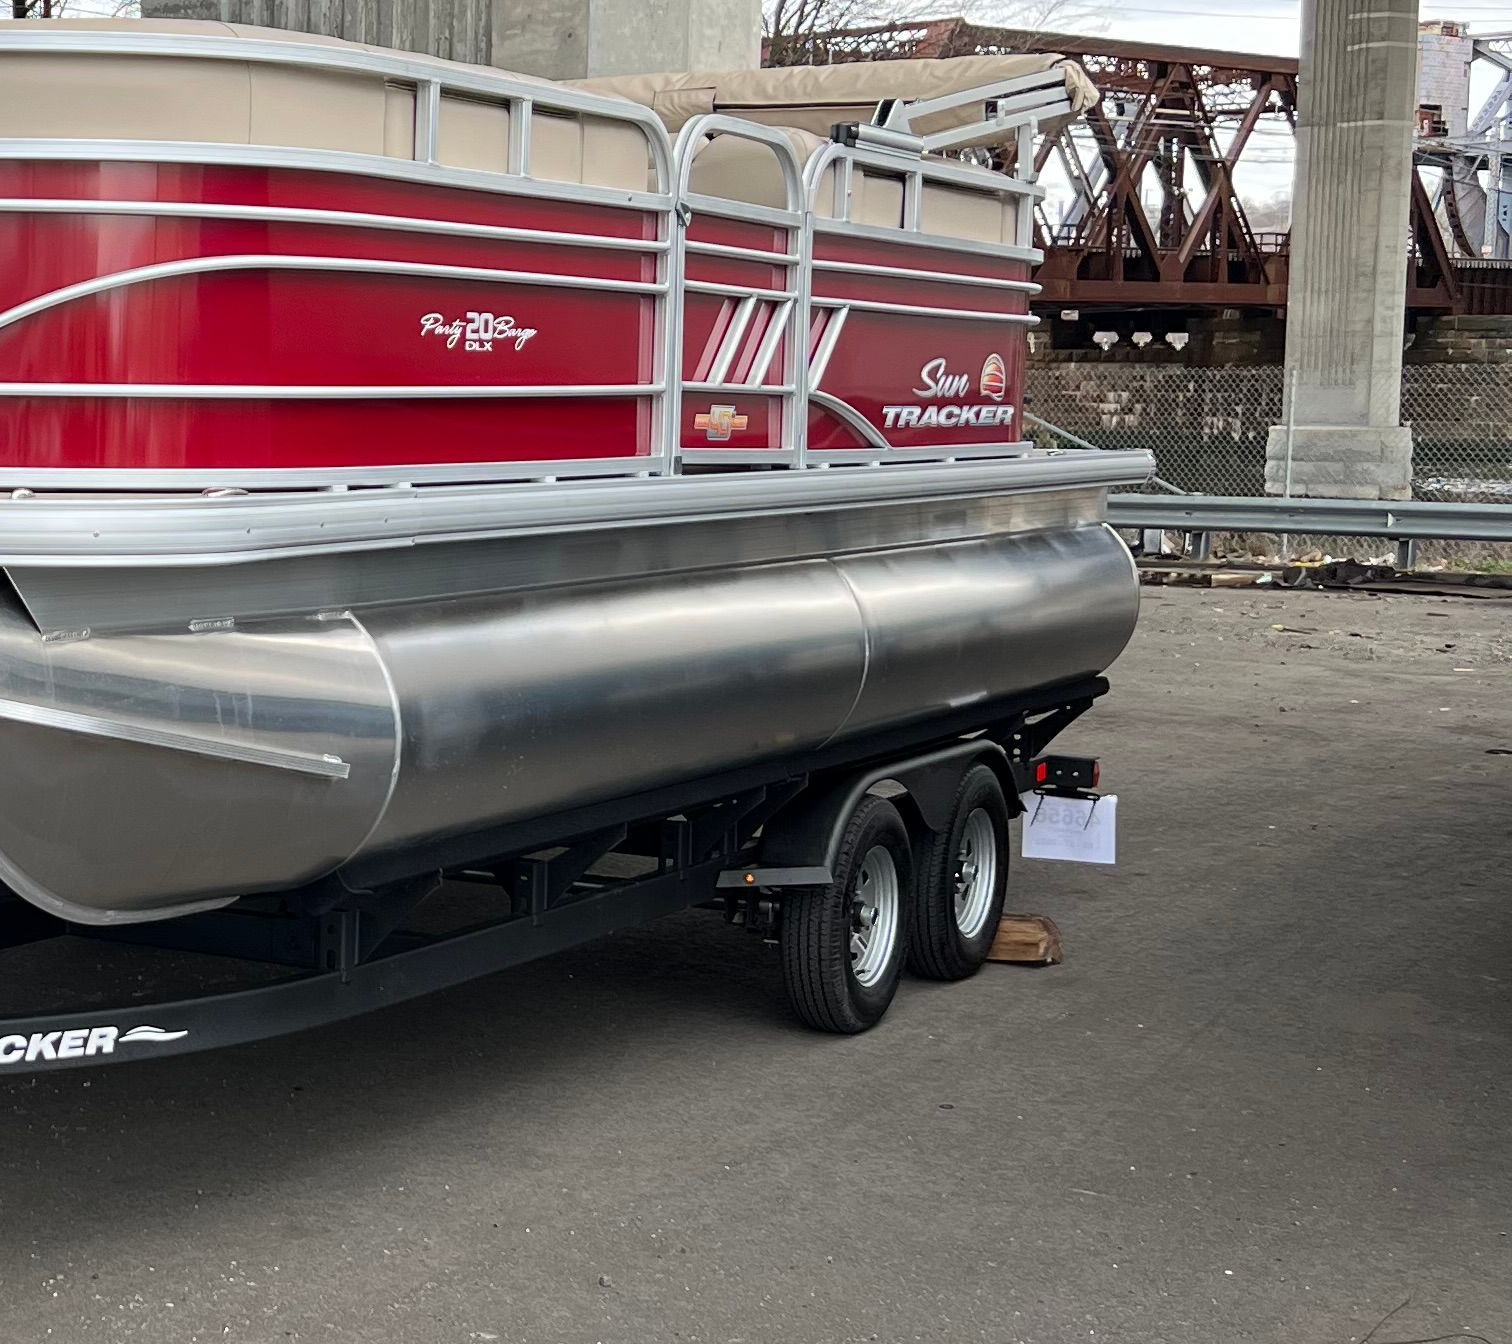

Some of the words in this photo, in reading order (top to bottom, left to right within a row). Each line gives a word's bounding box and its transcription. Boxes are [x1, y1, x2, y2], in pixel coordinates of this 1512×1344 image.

[420, 313, 466, 349] Party
[465, 311, 494, 340] 20
[493, 316, 538, 351] Barge
[465, 340, 493, 351] DLX
[912, 357, 970, 398] Sun
[882, 404, 1015, 429] TRACKER
